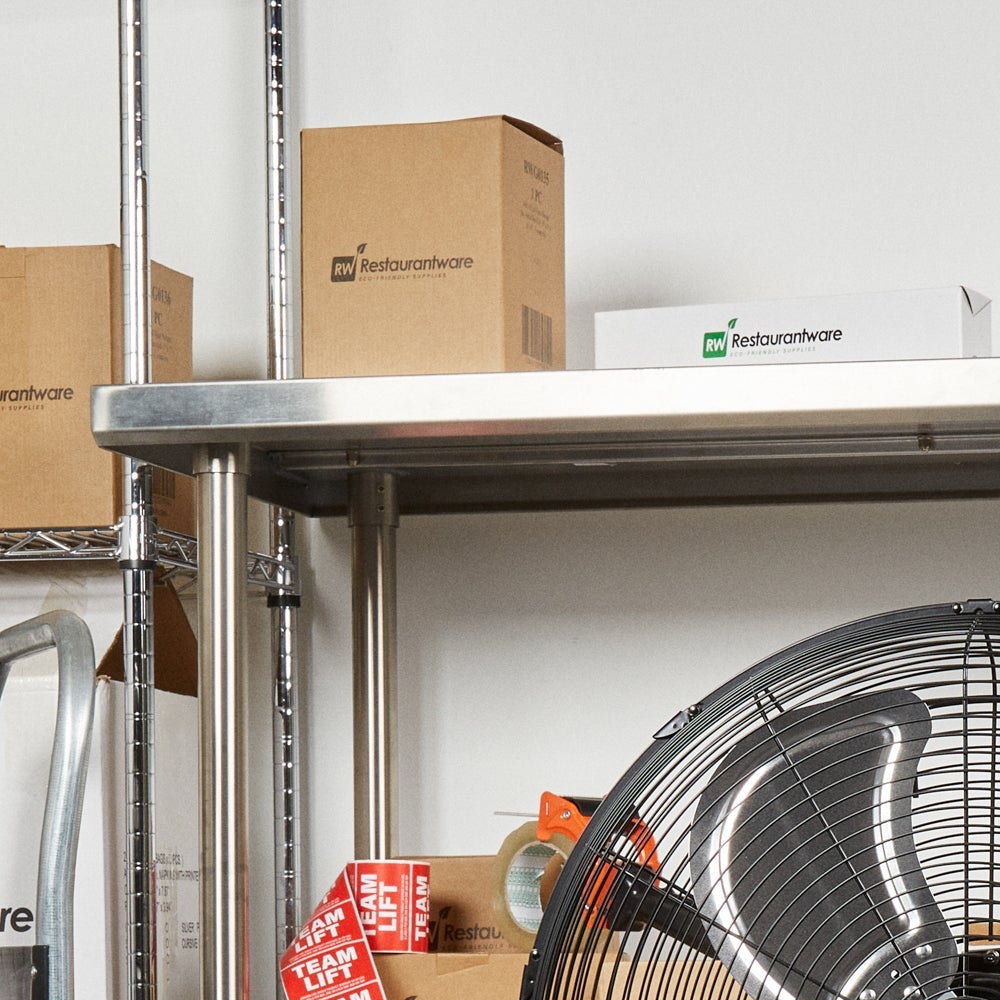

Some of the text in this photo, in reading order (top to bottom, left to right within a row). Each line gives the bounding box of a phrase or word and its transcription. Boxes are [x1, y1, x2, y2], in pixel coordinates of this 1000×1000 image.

[360, 255, 474, 273] Restaurantware
[413, 272, 447, 280] SUPPLIES
[705, 337, 727, 353] RW
[731, 328, 843, 349] Restaurantware
[783, 346, 816, 354] SUPPLIES
[360, 874, 378, 936] TEAM
[378, 881, 398, 932] LIFT
[414, 875, 428, 942] TEAM
[294, 923, 340, 954] LIFT
[299, 907, 345, 940] EAM
[291, 946, 358, 979] TEAM
[303, 963, 353, 992] LIFT
